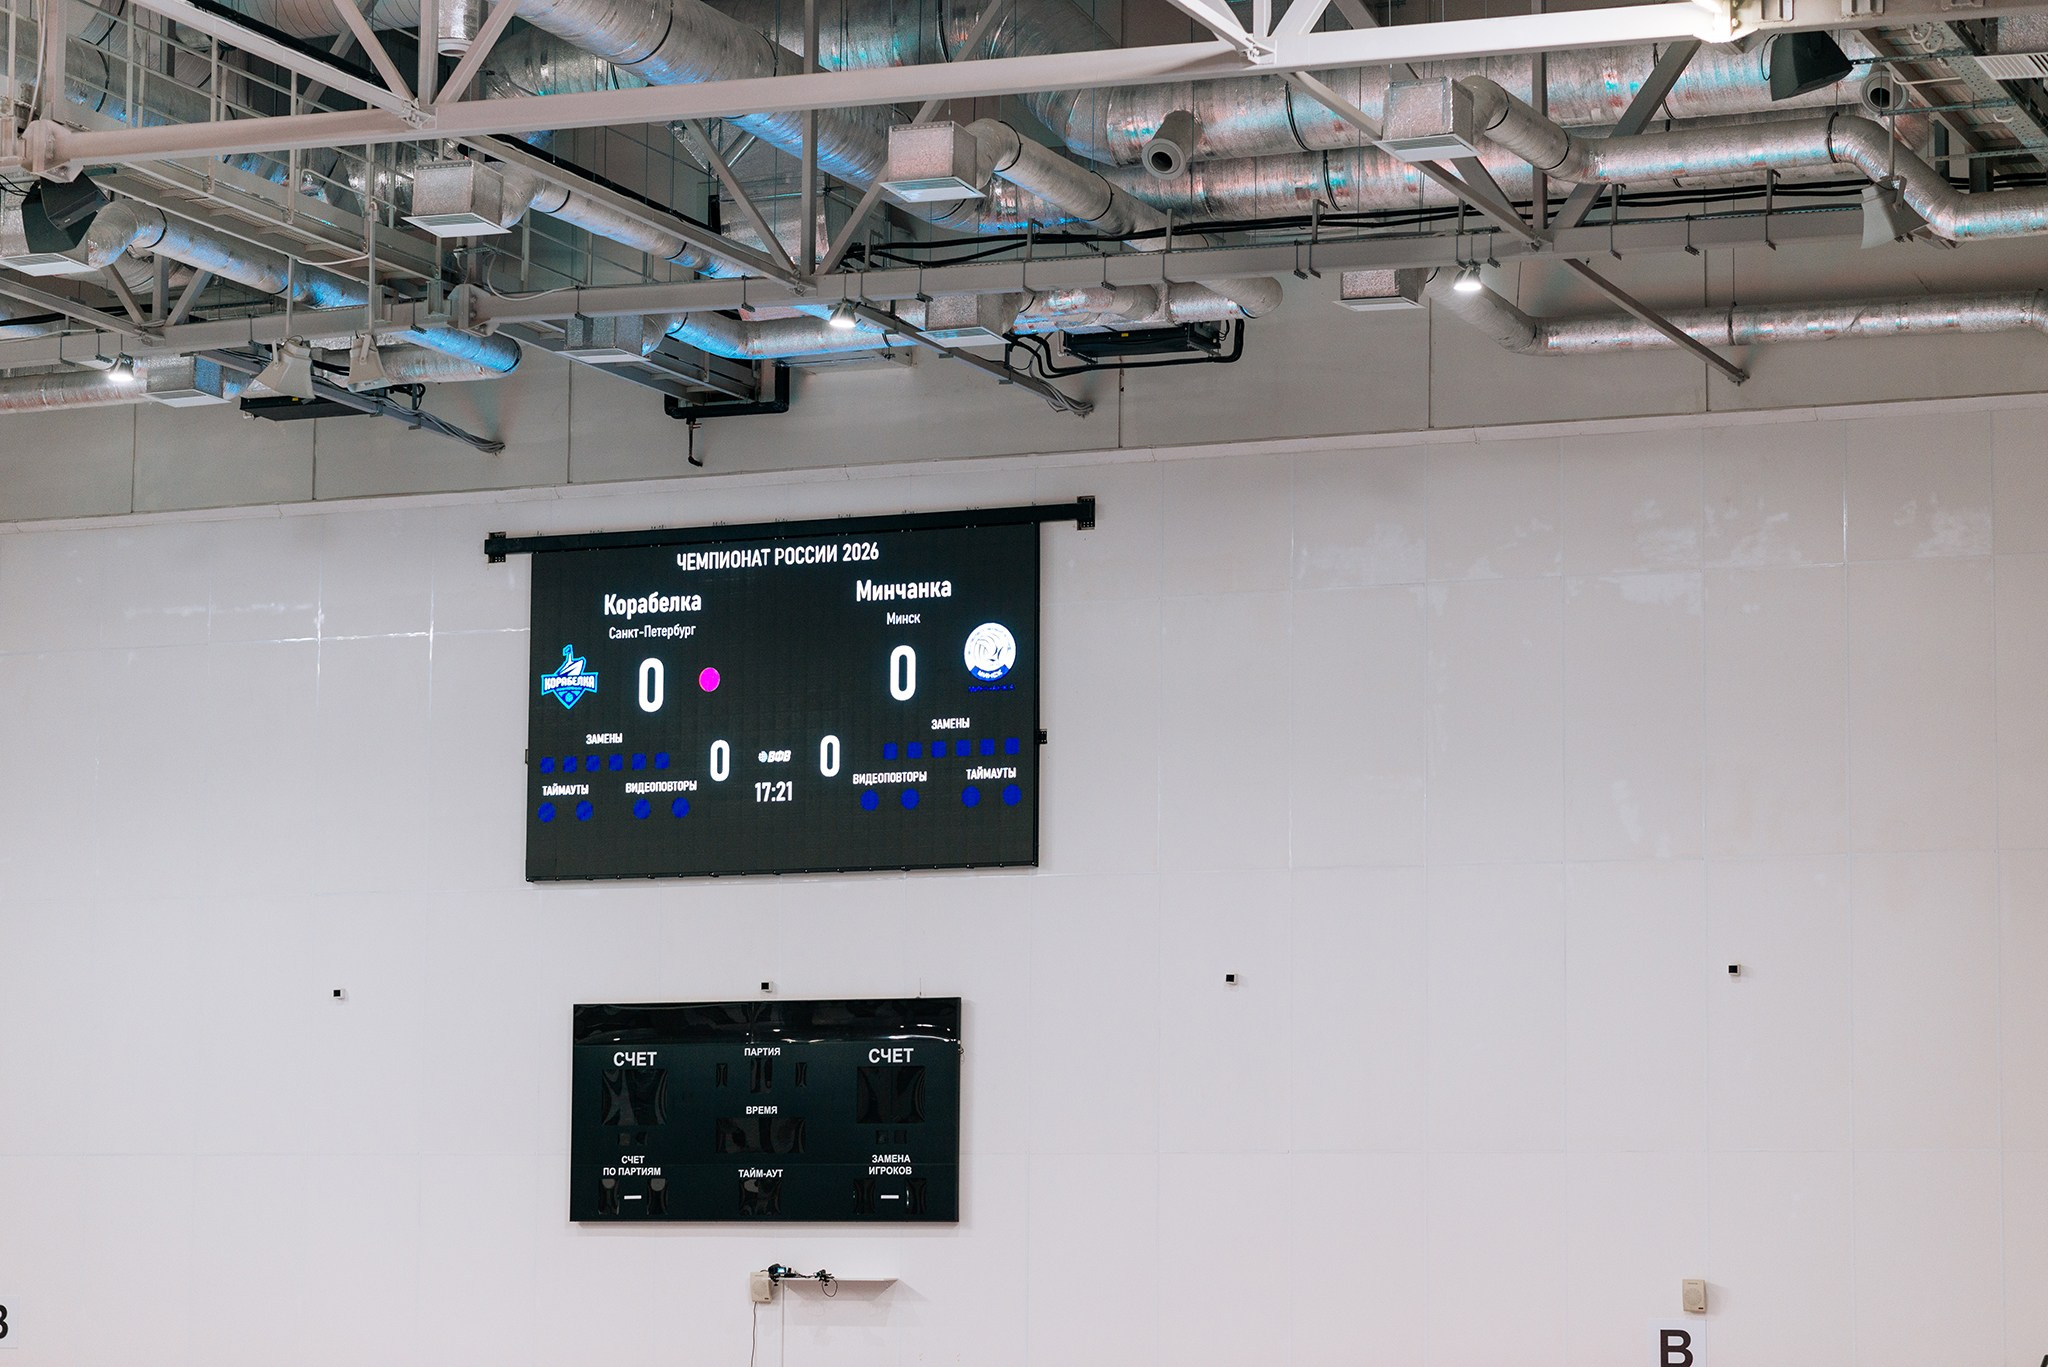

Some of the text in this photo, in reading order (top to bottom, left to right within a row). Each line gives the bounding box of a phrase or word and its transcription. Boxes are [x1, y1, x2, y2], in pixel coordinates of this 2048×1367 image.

[676, 541, 880, 572] ЧЕМПИОНАТ РОССИИ 2026
[856, 579, 952, 602] Минчанка
[603, 591, 702, 619] Корабелка
[886, 611, 921, 626] Минск
[608, 623, 697, 640] Санкт-Петербург
[889, 644, 917, 702] 0
[638, 657, 665, 713] 0
[930, 717, 971, 730] ЗАМЕНЫ
[585, 732, 623, 745] ЗАМЕНЫ
[709, 739, 731, 782] 0
[819, 734, 841, 778] 0
[852, 771, 928, 786] ВИДЕОПОВТОРЫ
[965, 766, 1017, 781] ТАЙМАУТЫ
[541, 783, 590, 797] ТАЙМАУТЫ
[625, 780, 698, 795] ВИДЕОПОВТОРЫ
[754, 780, 793, 803] 17:21
[613, 1051, 658, 1067] СЧЕТ
[744, 1047, 781, 1057] ПАРТИЯ
[868, 1047, 915, 1064] СЧЕТ
[745, 1105, 778, 1115] ВРЕМЯ
[621, 1155, 645, 1165] СЧЕТ
[871, 1154, 911, 1164] ЗАМЕНА
[602, 1167, 661, 1176] ПО ПАРТИЯМ
[737, 1167, 784, 1178] ТАЙМ-АУТ
[868, 1166, 913, 1176] ИГРОКОВ
